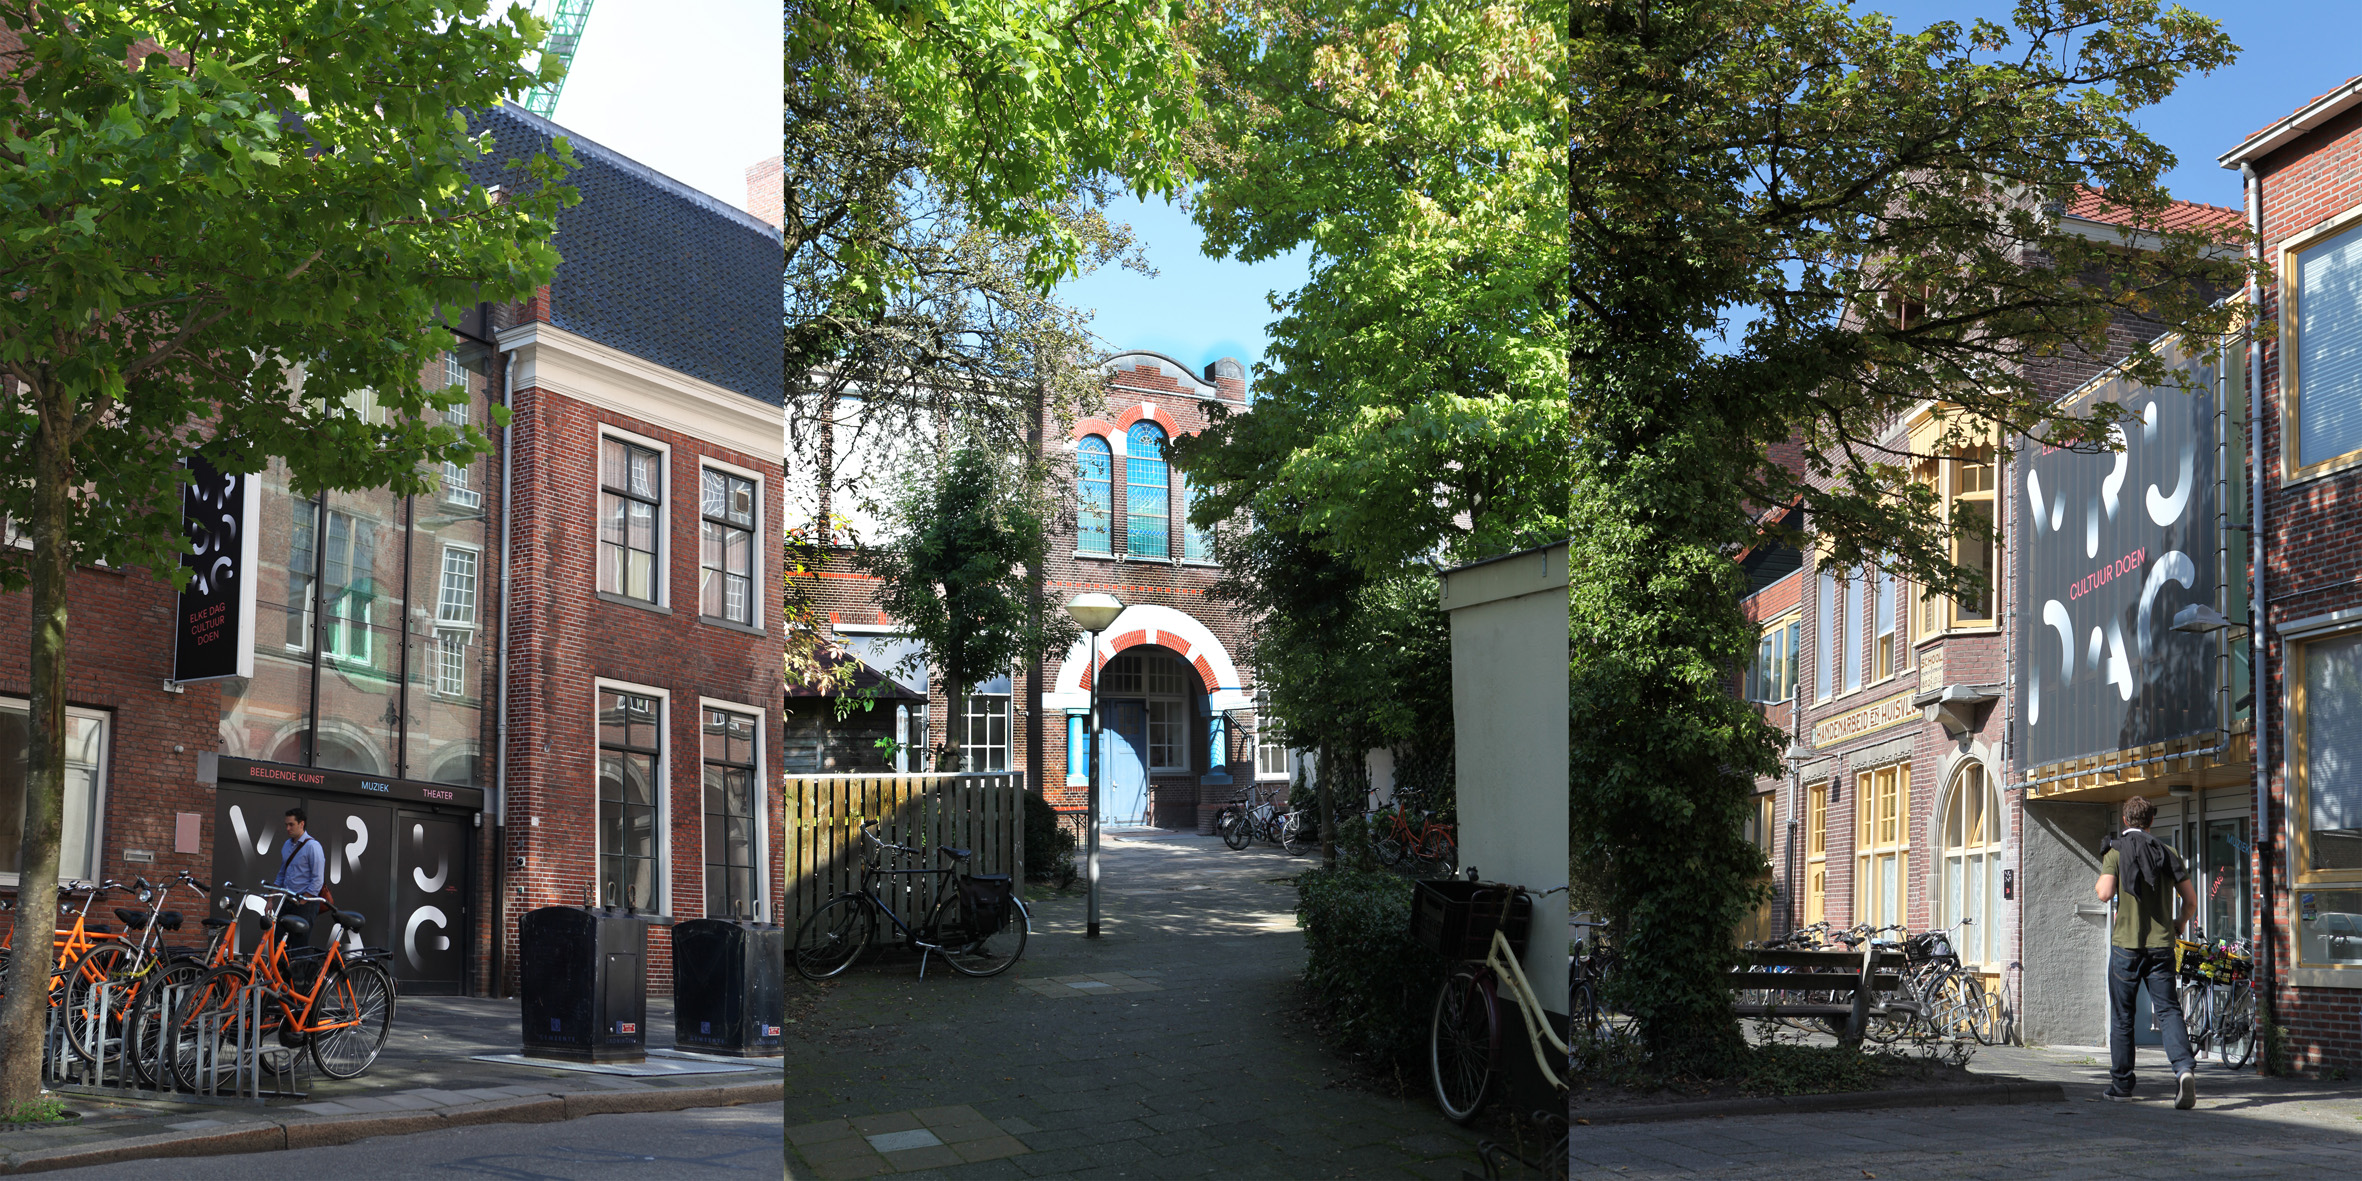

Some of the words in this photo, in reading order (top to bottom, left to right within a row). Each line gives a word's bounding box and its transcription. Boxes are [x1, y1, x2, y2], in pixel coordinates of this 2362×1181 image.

[2070, 564, 2113, 600] CULTUUR
[2115, 546, 2145, 577] DOEN
[189, 607, 208, 624] ELKE
[209, 602, 226, 616] DAG
[191, 615, 225, 635] CULTUUR
[197, 630, 220, 646] DOEN
[1921, 652, 1943, 669] SCHOOL
[1816, 711, 1869, 745] HANDENARBEID
[1870, 708, 1880, 725] EN
[250, 766, 297, 782] BEELDENDE
[298, 773, 325, 785] KUNST
[361, 780, 390, 793] MUZIEK
[422, 788, 453, 800] THEATER
[2226, 833, 2250, 856] MUZIEK
